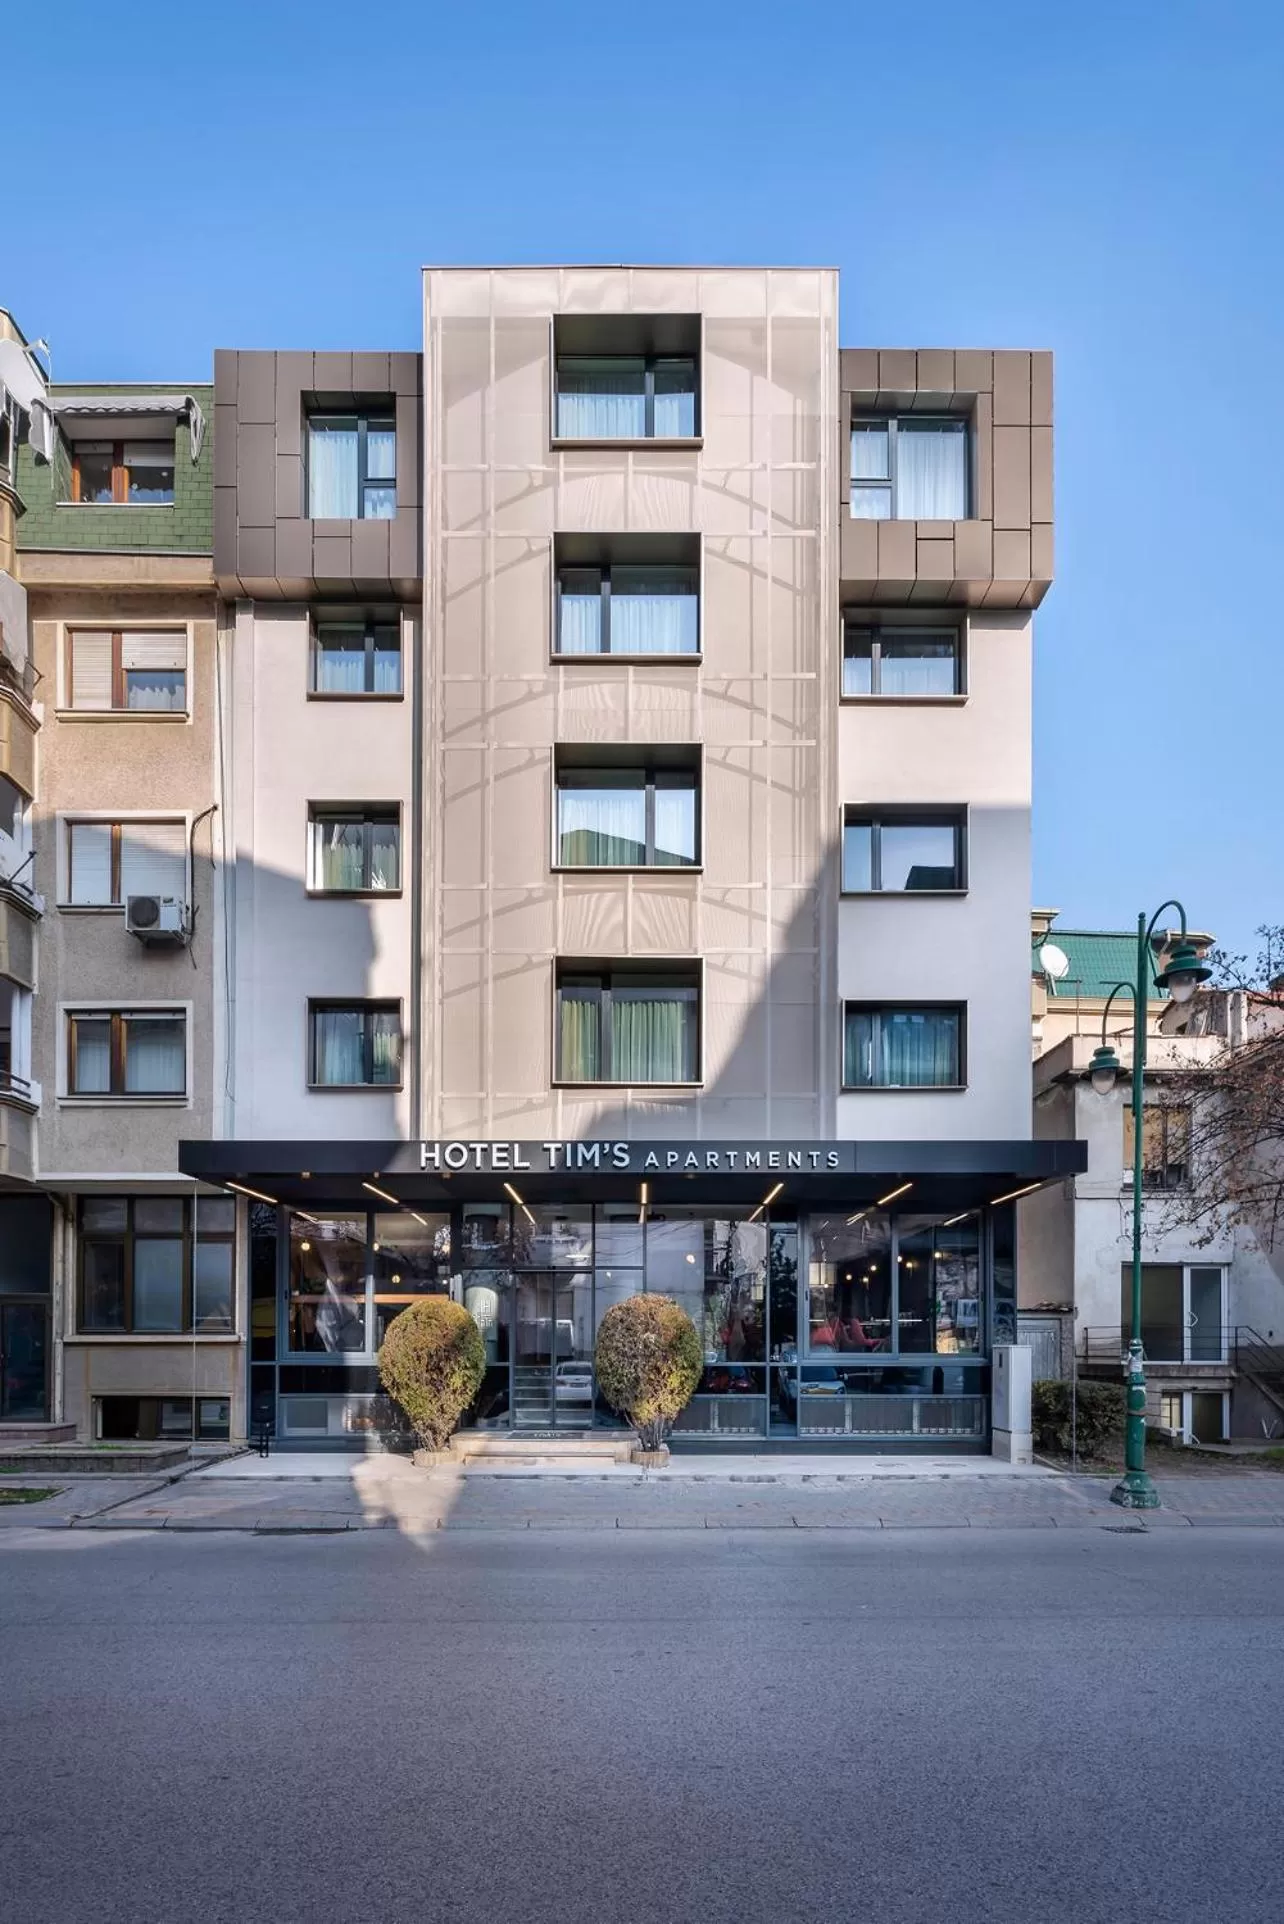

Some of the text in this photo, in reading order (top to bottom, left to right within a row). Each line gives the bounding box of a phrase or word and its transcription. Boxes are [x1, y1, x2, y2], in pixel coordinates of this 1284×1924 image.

[421, 1142, 840, 1168] HOTEL TIM'S APARTMENTS
